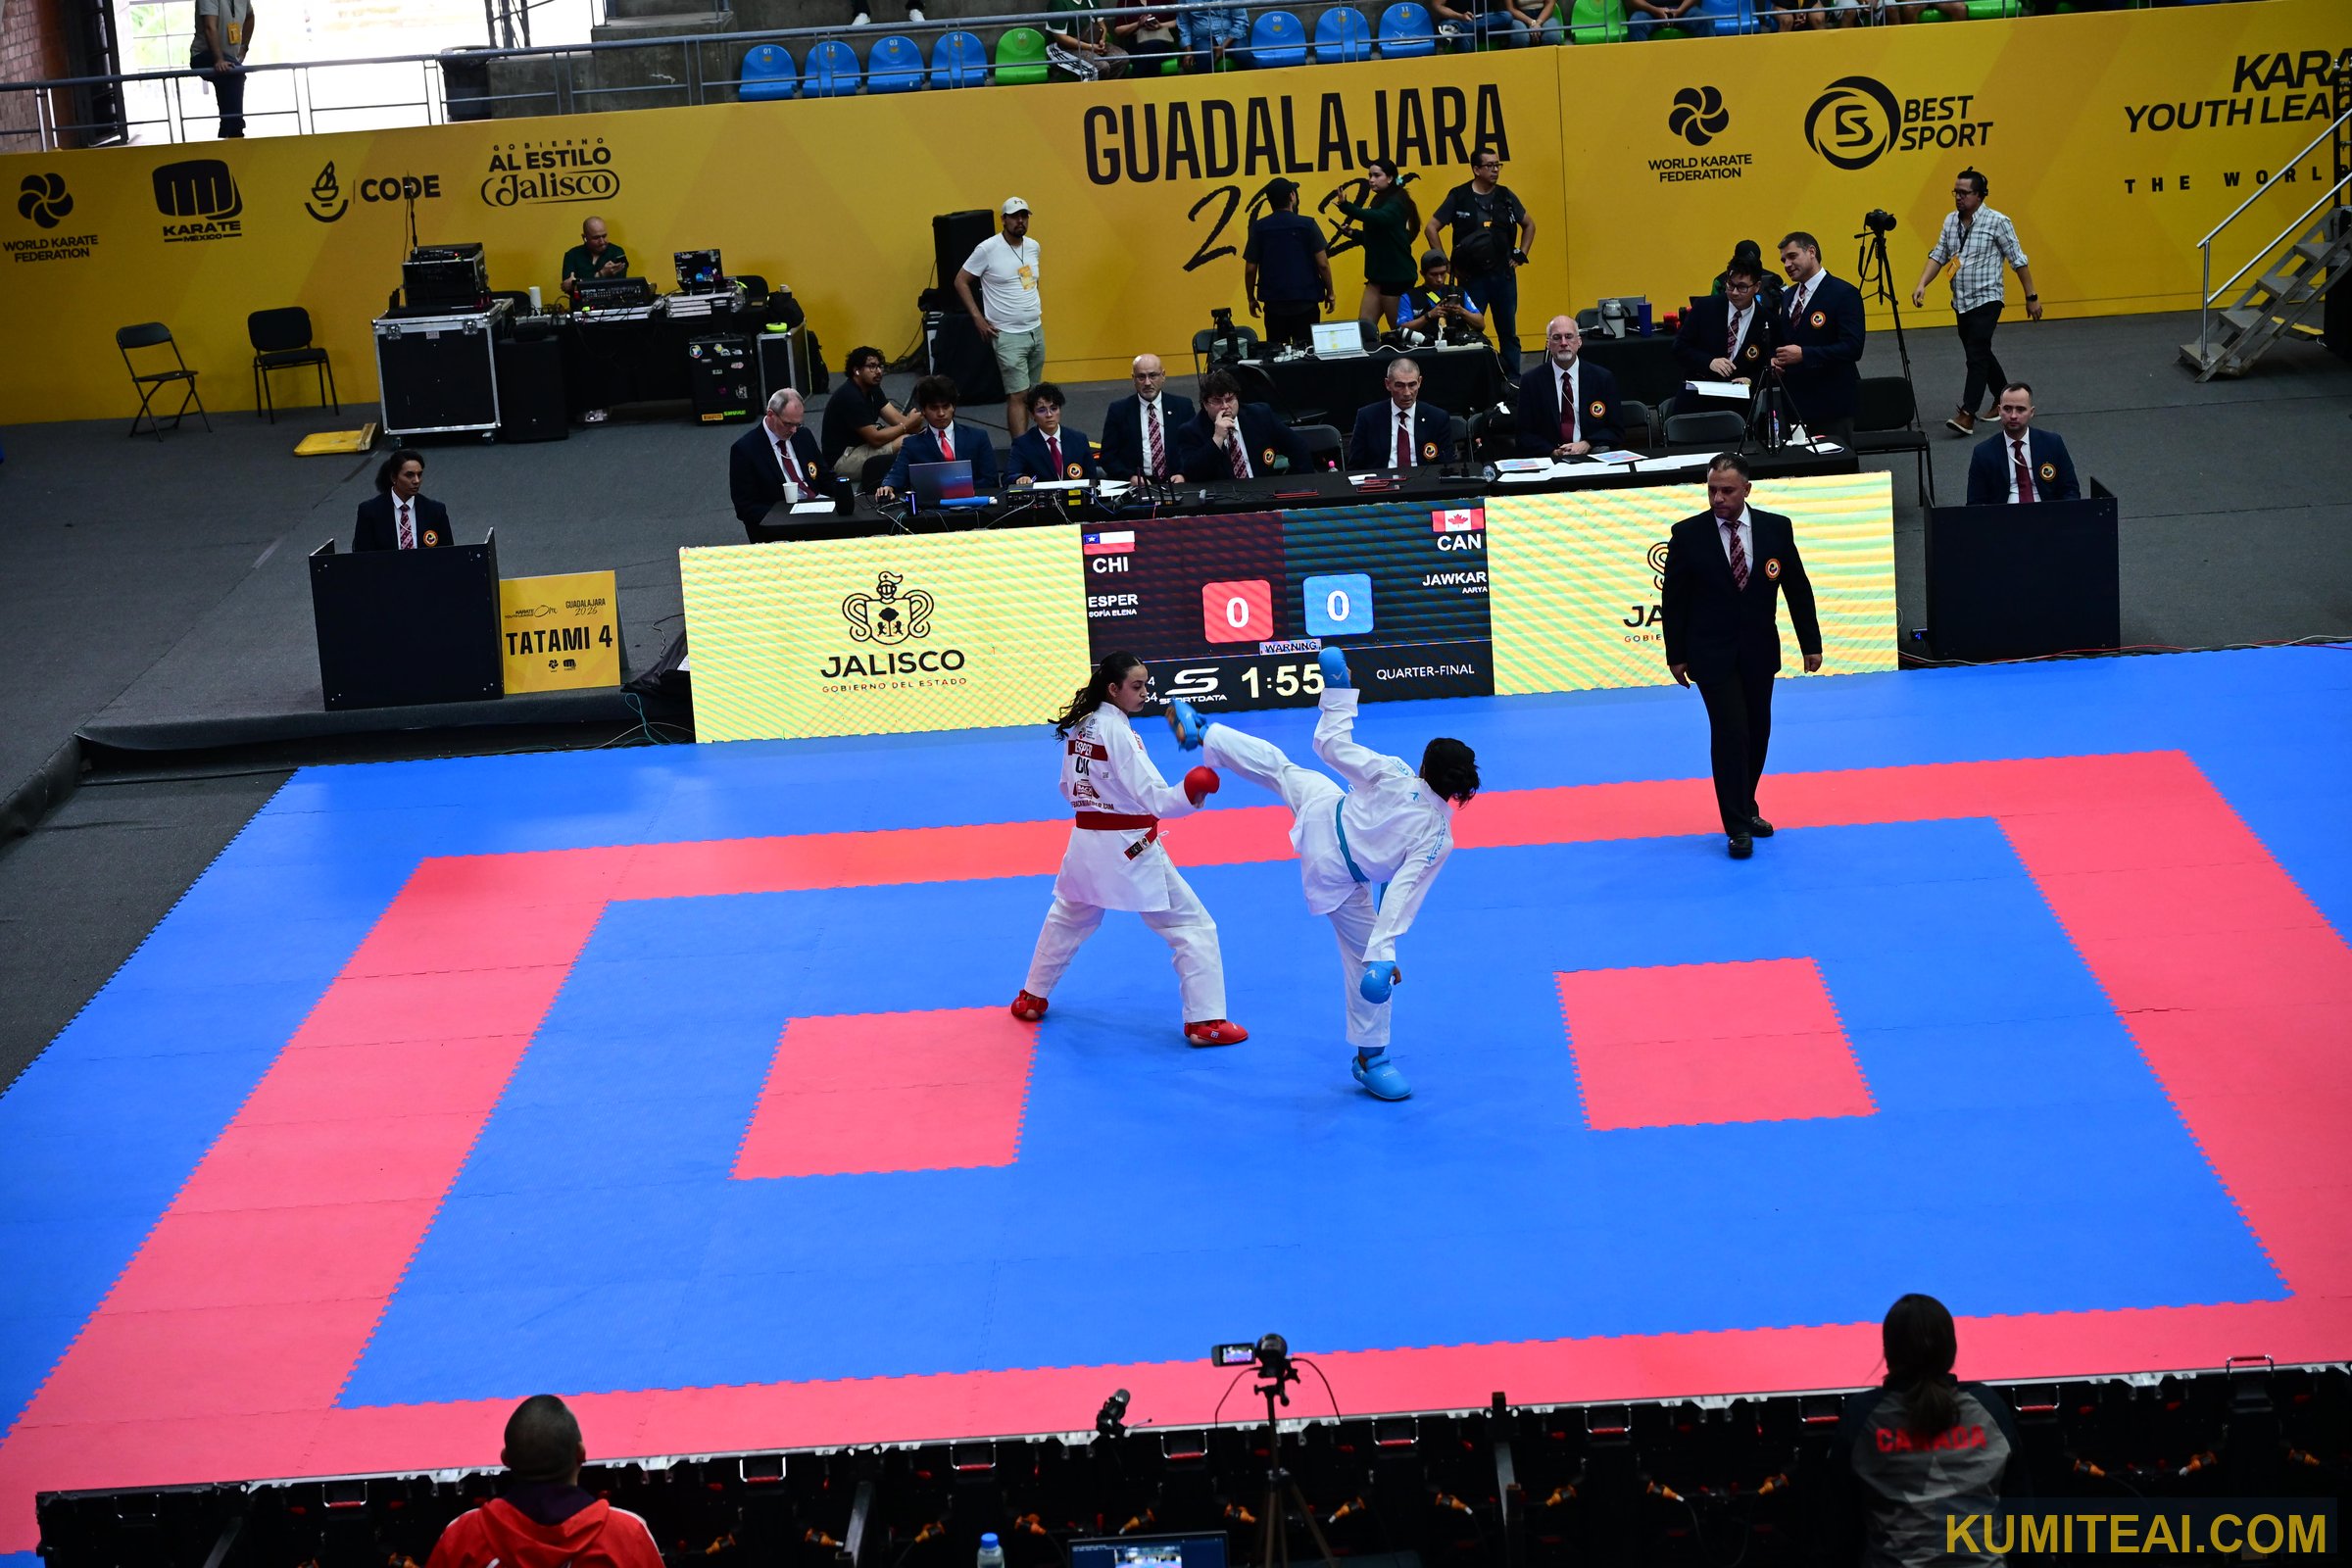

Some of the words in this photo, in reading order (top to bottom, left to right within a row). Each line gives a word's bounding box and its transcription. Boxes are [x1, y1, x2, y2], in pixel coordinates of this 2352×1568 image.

[1904, 95, 1974, 122] BEST
[2125, 98, 2253, 132] YOUTH
[1083, 83, 1510, 185] GUADALAJARA
[1900, 122, 1993, 151] SPORT
[493, 136, 605, 151] GOBIERNO
[489, 153, 520, 172] AL
[526, 147, 611, 170] ESTILO
[1648, 157, 1698, 171] WORLD
[1700, 154, 1752, 168] KARATE
[1659, 168, 1741, 182] FEDERATION
[2125, 175, 2190, 193] THE
[361, 174, 441, 203] CODE
[495, 172, 611, 207] Jalisco
[163, 220, 241, 236] KARATE
[3, 239, 49, 252] WORLD
[51, 234, 98, 248] KARATE
[15, 247, 90, 263] FEDERATION
[1437, 533, 1482, 552] CAN
[1092, 556, 1129, 573] CHI
[1422, 571, 1487, 587] JAWKAR
[565, 598, 606, 609] GUADALAJARA
[1088, 594, 1139, 608] ESPER
[1326, 590, 1350, 622] 0
[1225, 597, 1250, 628] 0
[506, 626, 590, 656] TATAMI
[599, 625, 612, 648] 4
[1264, 641, 1317, 654] WARNING
[820, 649, 965, 678] JALISCO
[1376, 663, 1474, 681] QUARTER-FINAL
[822, 682, 887, 693] GOBIERNO
[892, 680, 913, 689] DEL
[919, 677, 967, 687] ESTADO
[1242, 663, 1325, 699] 1:55
[1075, 741, 1093, 757] ESPER
